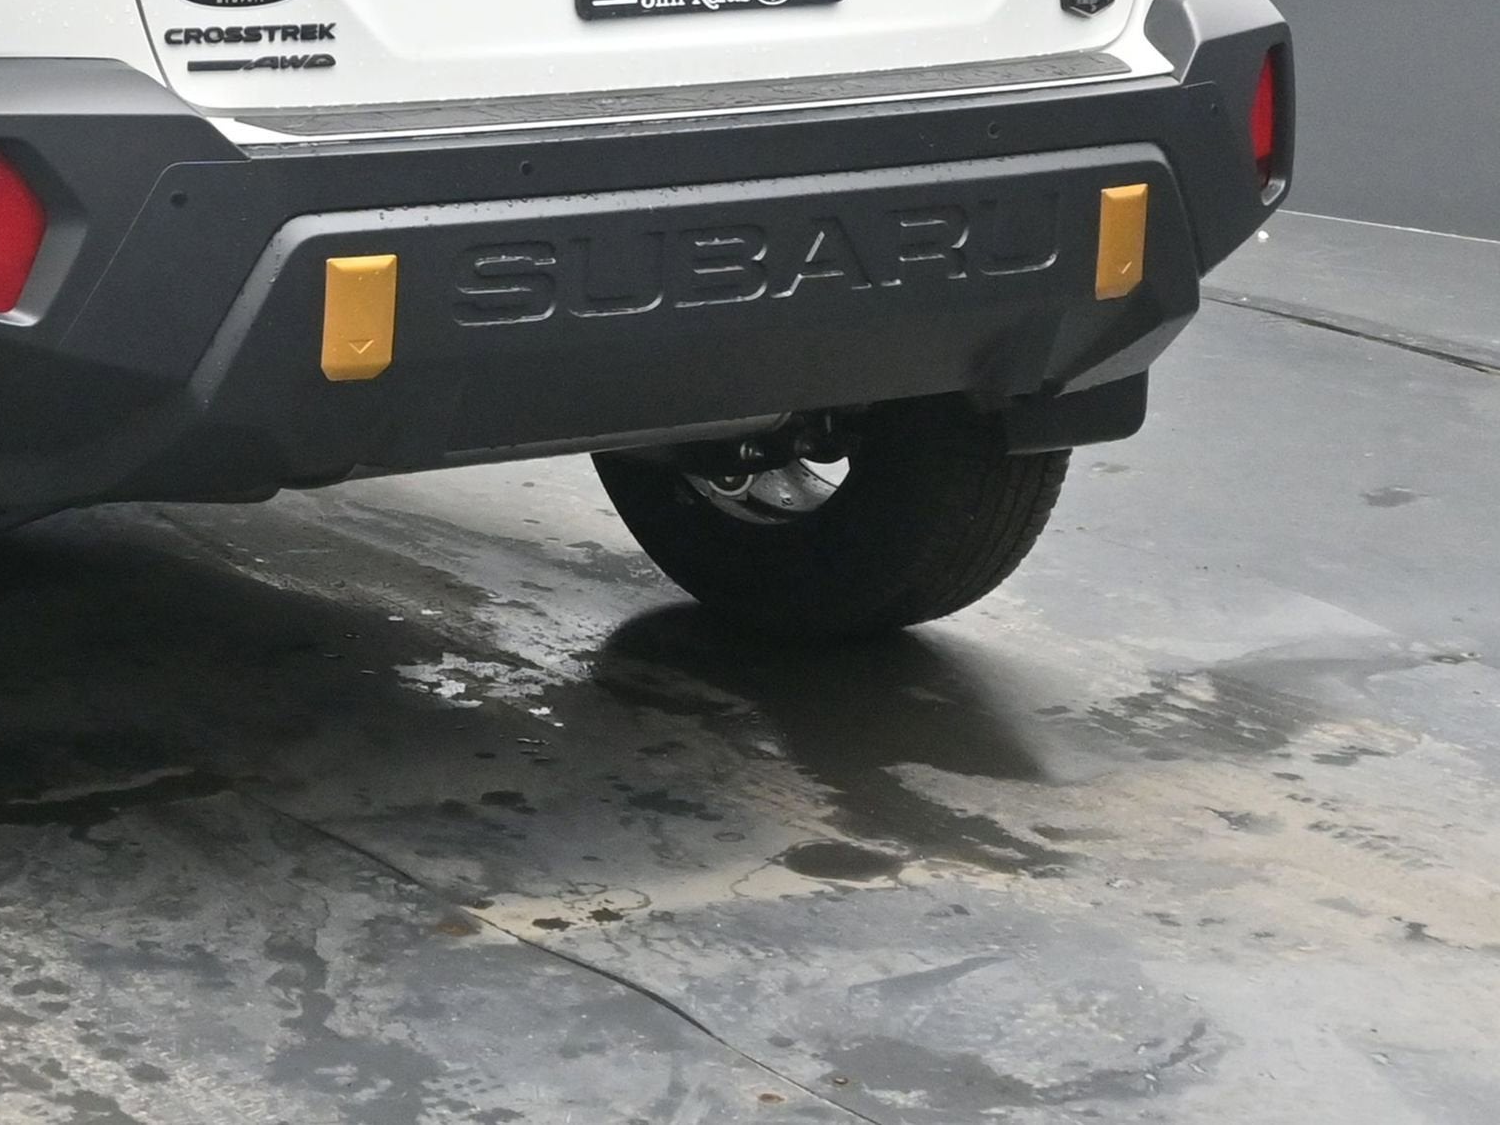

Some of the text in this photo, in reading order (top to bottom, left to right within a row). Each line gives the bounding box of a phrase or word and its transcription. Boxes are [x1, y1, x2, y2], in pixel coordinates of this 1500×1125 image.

[164, 22, 337, 46] CROSSTREK
[243, 53, 336, 70] AWD
[453, 191, 1062, 326] SUBARU
